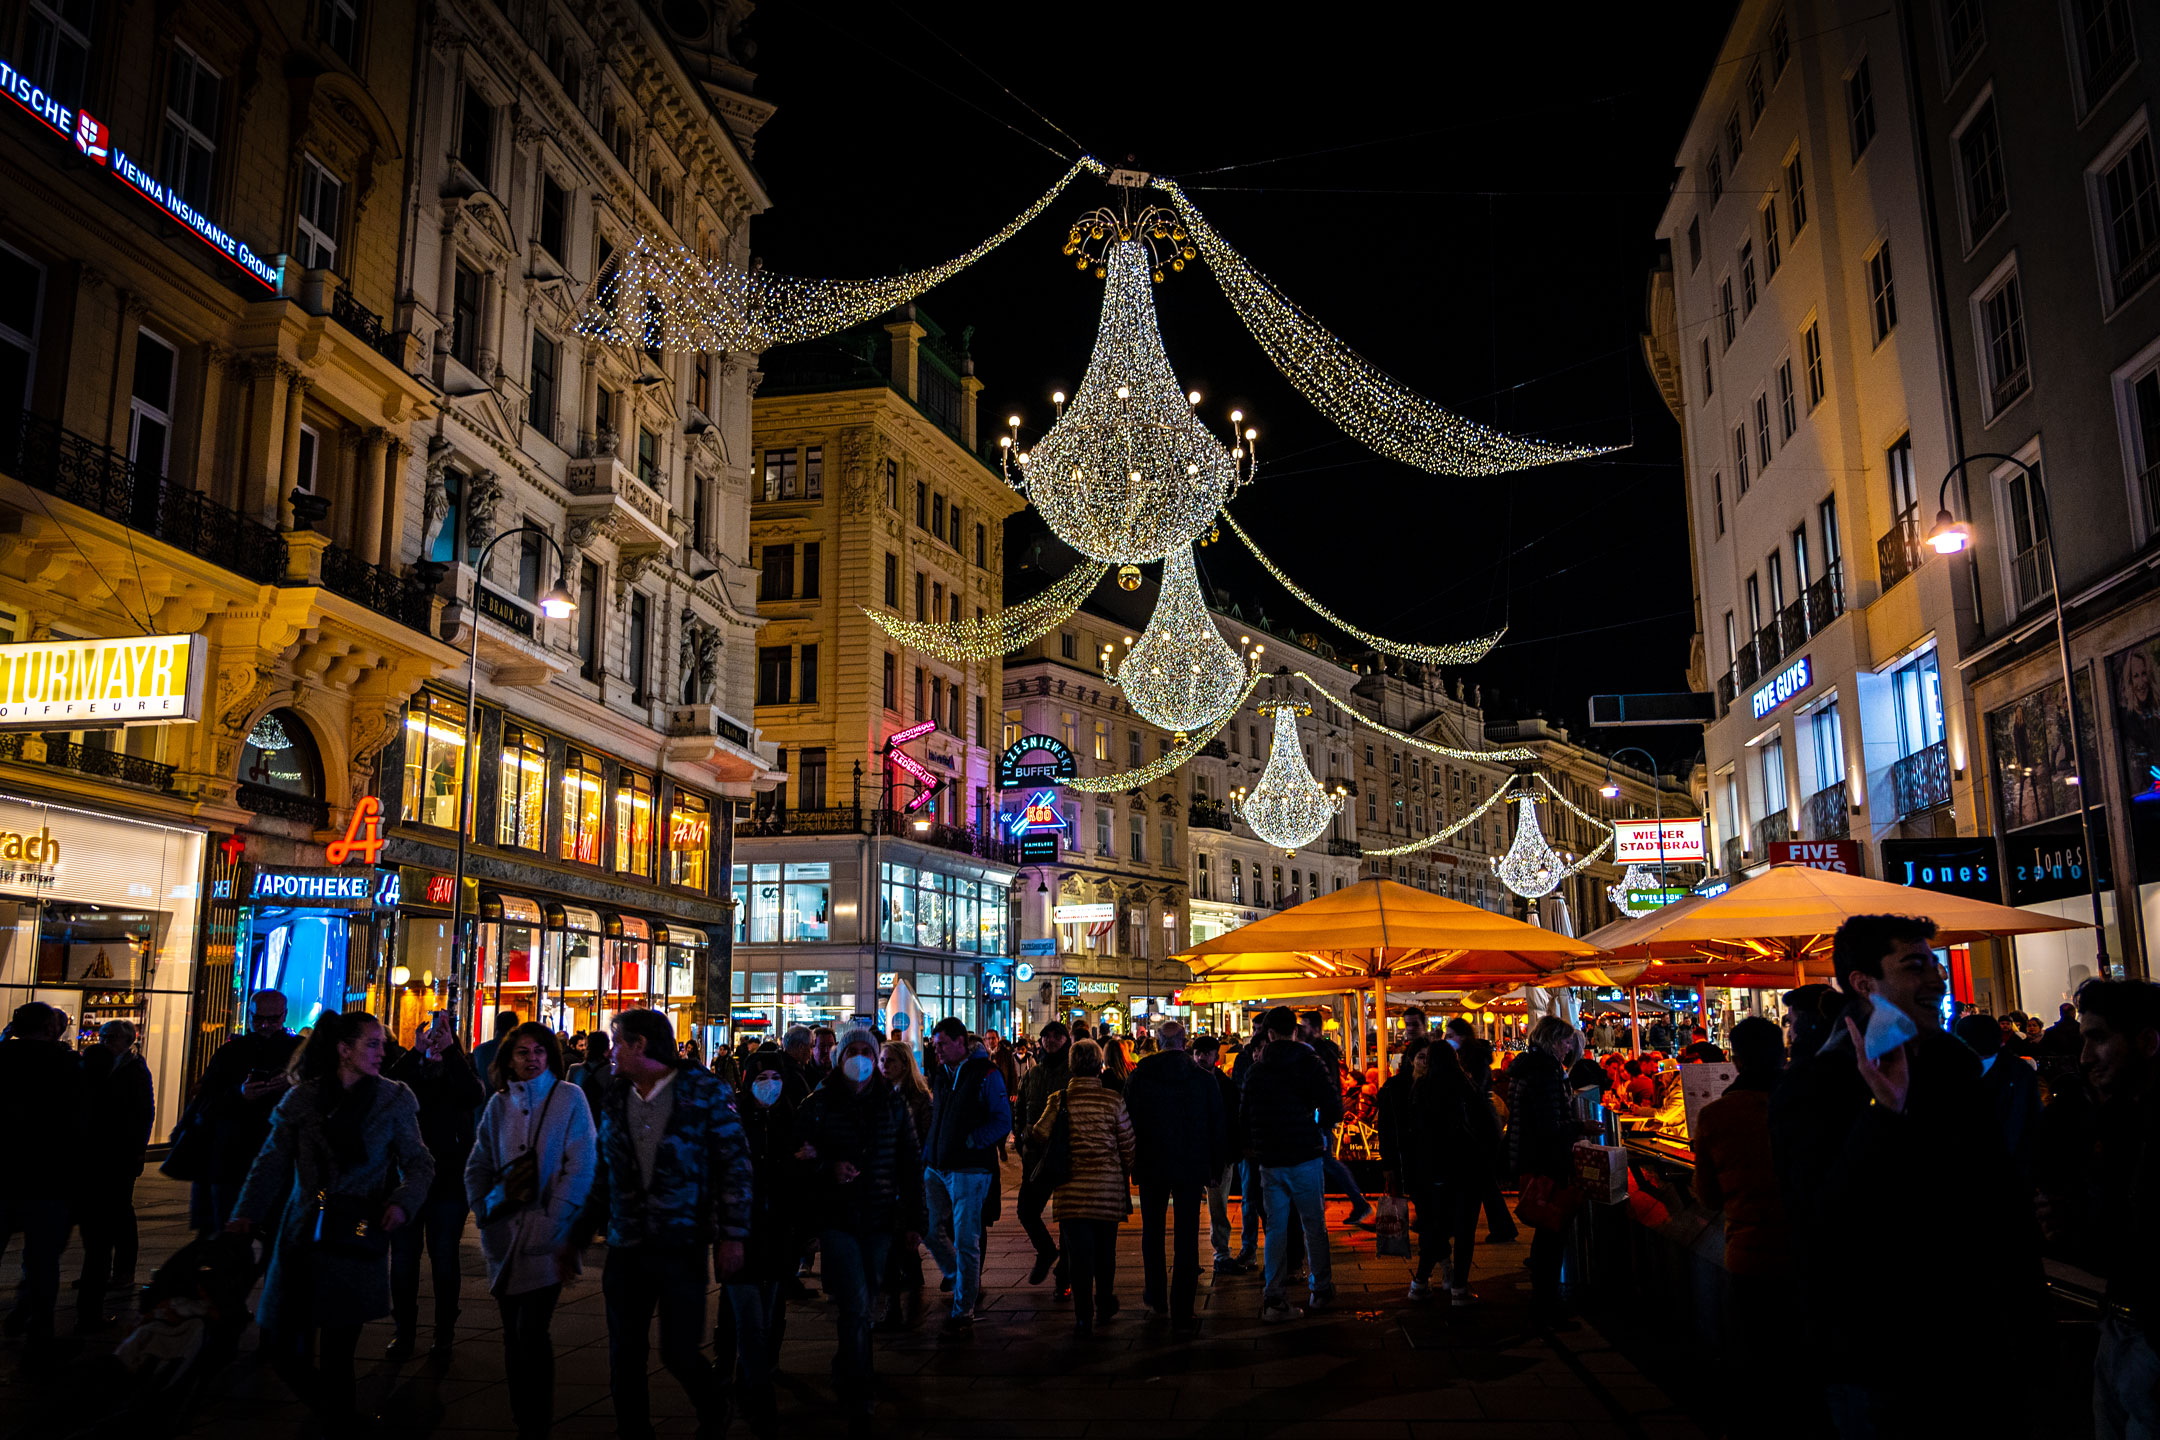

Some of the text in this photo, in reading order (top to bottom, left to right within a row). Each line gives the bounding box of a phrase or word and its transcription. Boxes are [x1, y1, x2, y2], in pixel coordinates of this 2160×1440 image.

[114, 147, 277, 284] VIENNA INSURANCE GROUP
[489, 597, 513, 622] BRAUN
[0, 645, 174, 704] TURMAYR
[1753, 659, 1806, 719] FIVE GUYS
[890, 749, 937, 788] FLEDERMAUS
[1015, 765, 1058, 777] BUFFET
[672, 820, 705, 844] H&M
[1633, 830, 1684, 840] WIENER
[1620, 841, 1699, 851] STADTBRAU
[1789, 844, 1839, 860] FIVE
[1902, 861, 1987, 887] Jones
[2034, 846, 2082, 882] Jones
[262, 876, 365, 899] APOTHEKE
